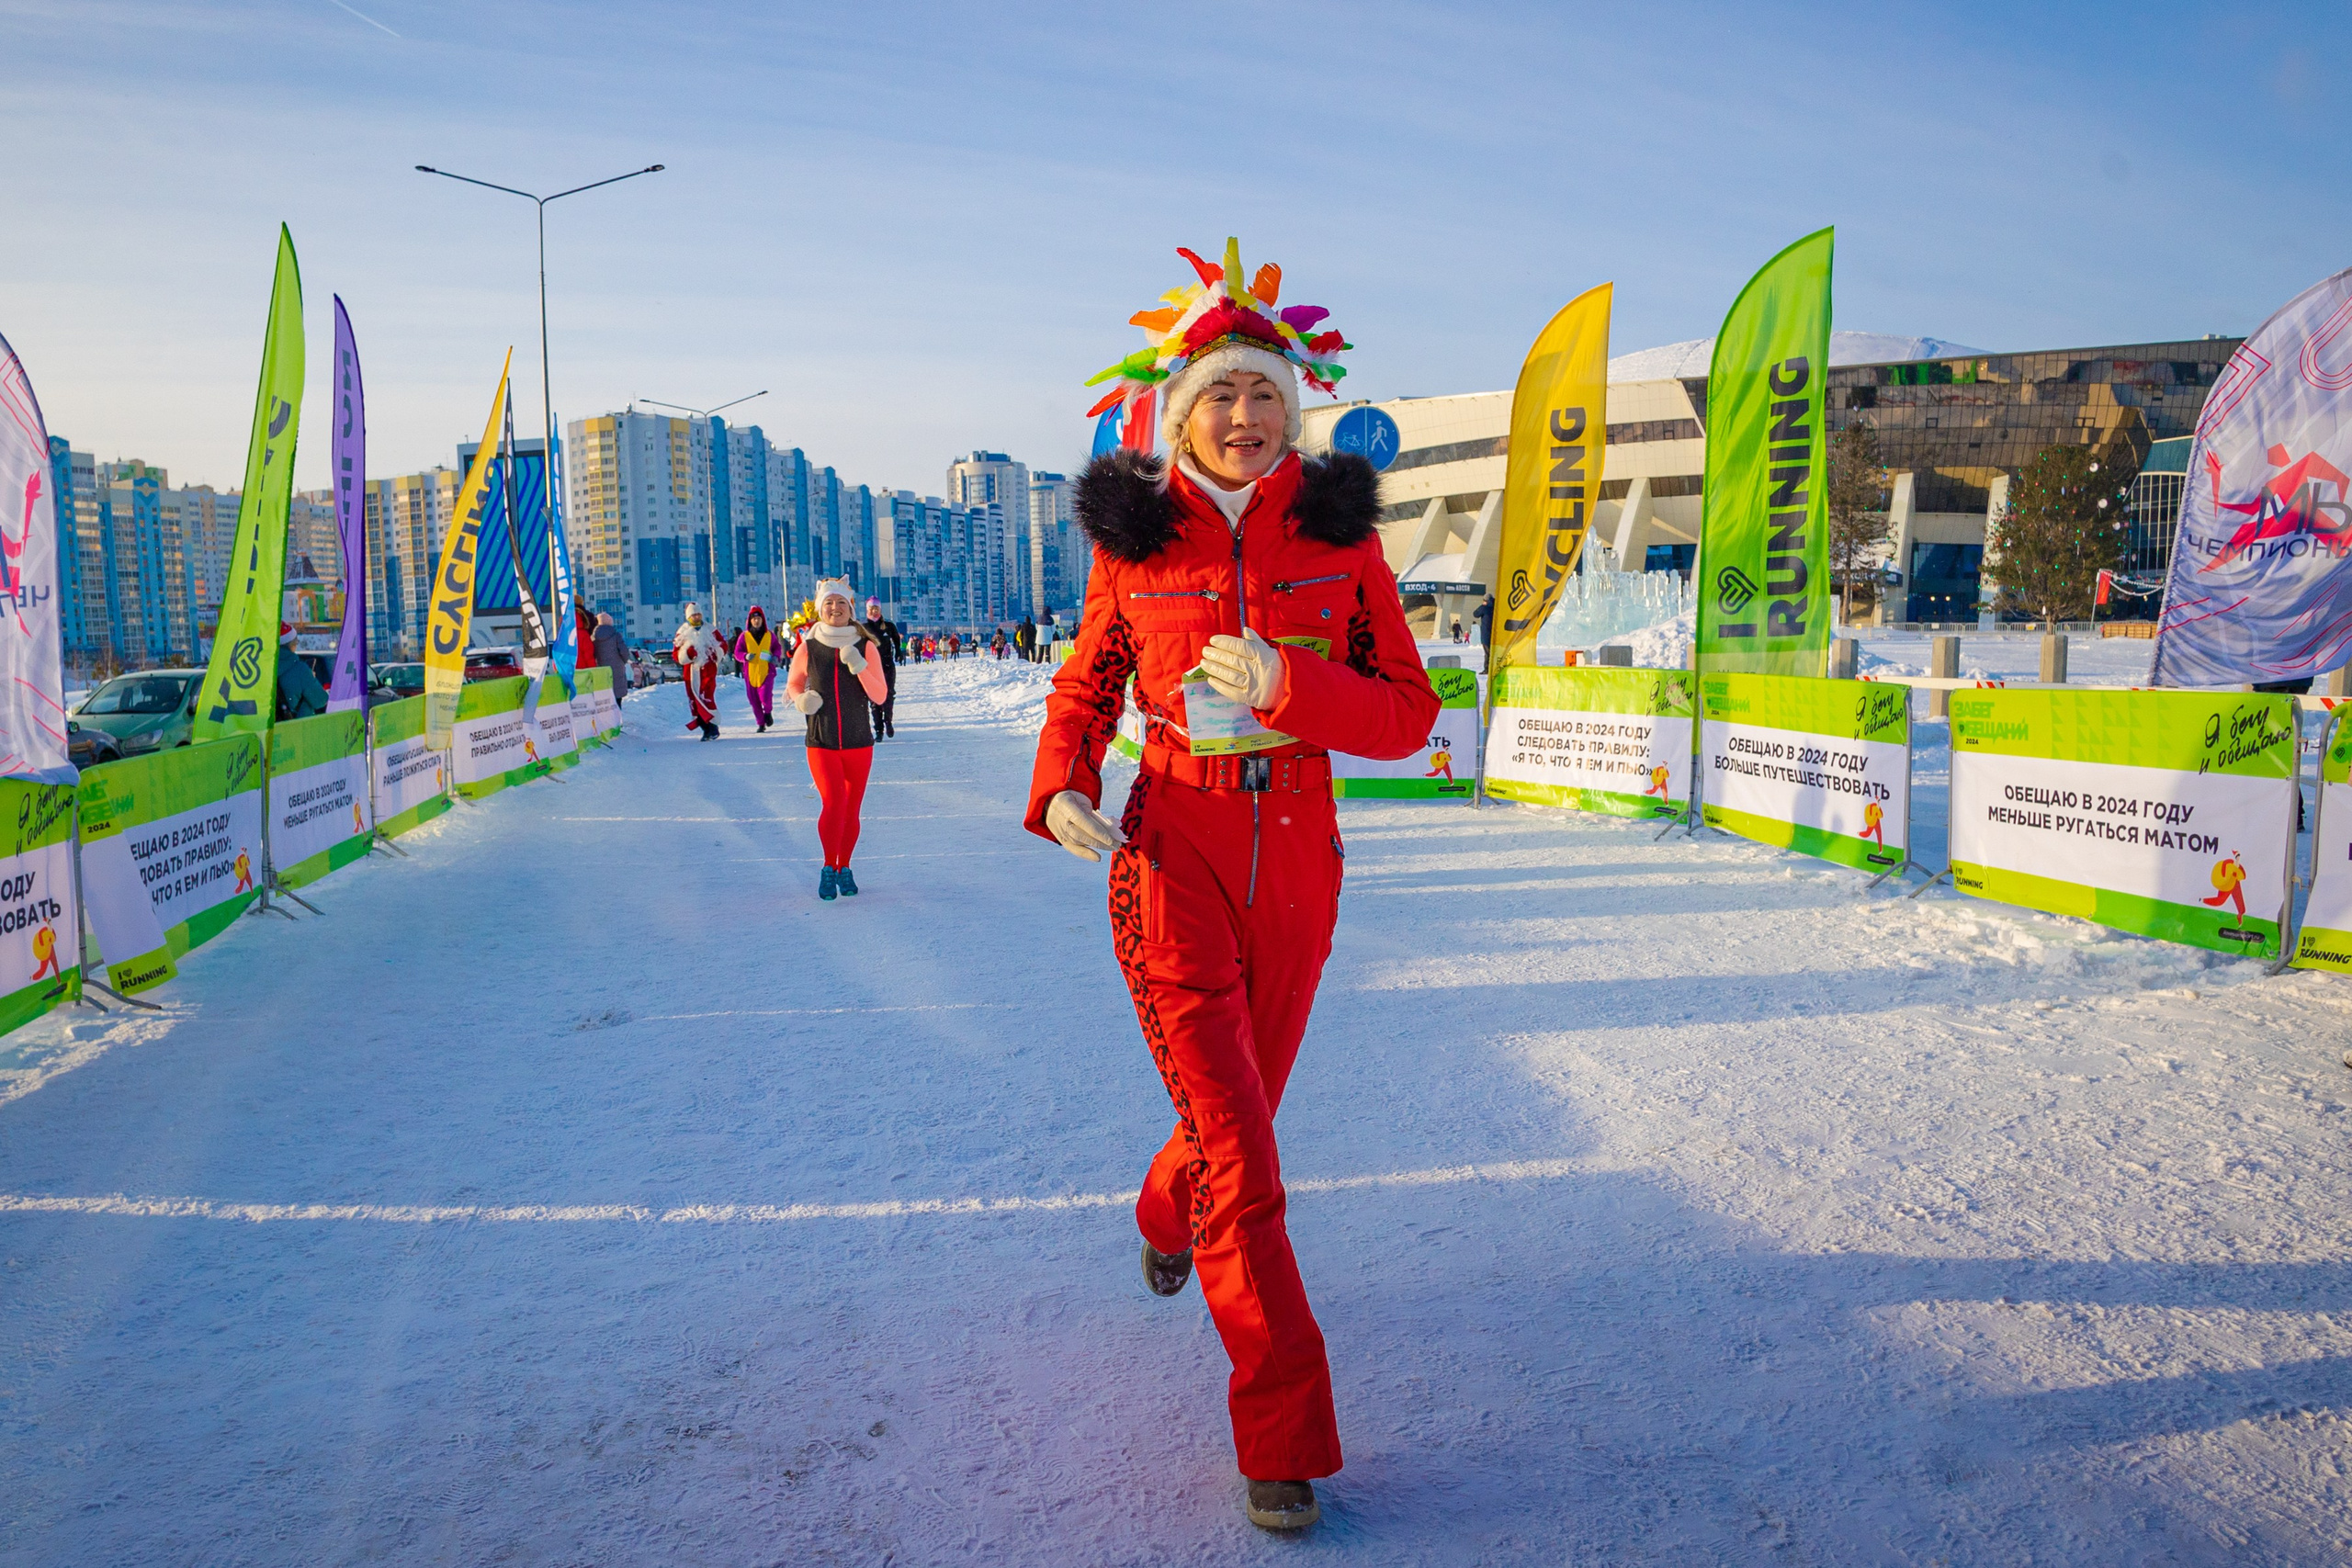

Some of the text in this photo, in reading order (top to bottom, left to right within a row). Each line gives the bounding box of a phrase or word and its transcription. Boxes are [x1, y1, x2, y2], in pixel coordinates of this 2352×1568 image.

[1767, 355, 1811, 637] RUNNING
[1856, 696, 1866, 721] Я
[2205, 704, 2269, 749] Я бегу
[1517, 735, 1650, 759] СЛЕДОВАТЬ ПРАВИЛУ:
[1518, 718, 1652, 741] ОБЕЩАЮ В 2024 ГОДУ
[2218, 726, 2291, 768] обещаю
[1528, 753, 1546, 768] ТО,
[1549, 755, 1571, 768] ЧТО
[1576, 758, 1582, 770] Я
[1585, 759, 1602, 772] ЕМ
[1606, 761, 1614, 773] И
[1616, 761, 1653, 776] ПЬЮ»
[1728, 737, 1869, 773] ОБЕЩАЮ В 2024 ГОДУ
[288, 778, 346, 808] ОБЕЩАЮ В 2024 ГОДУ
[1714, 755, 1891, 801] БОЛЬШЕ ПУТЕШЕСТВОВАТЬ
[18, 792, 30, 829] Я
[283, 793, 353, 829] МЕНЬШЕ РУГАТЬСЯ МАТОМ
[2005, 784, 2195, 825] ОБЕЩАЮ В 2024 ГОДУ
[87, 821, 110, 833] 2024
[172, 830, 179, 848] В
[181, 826, 204, 845] 2024
[207, 812, 232, 836] ГОДУ
[1988, 806, 2219, 855] МЕНЬШЕ РУГАТЬСЯ МАТОМ
[184, 836, 232, 868] ПРАВИЛУ:
[152, 885, 173, 906] ЧТО
[175, 879, 182, 896] Я
[185, 874, 199, 893] ЕМ
[200, 871, 208, 886] И
[0, 897, 62, 937] ОВАТЬ
[2299, 948, 2352, 964] RUNNING
[120, 964, 167, 989] RUNNING
